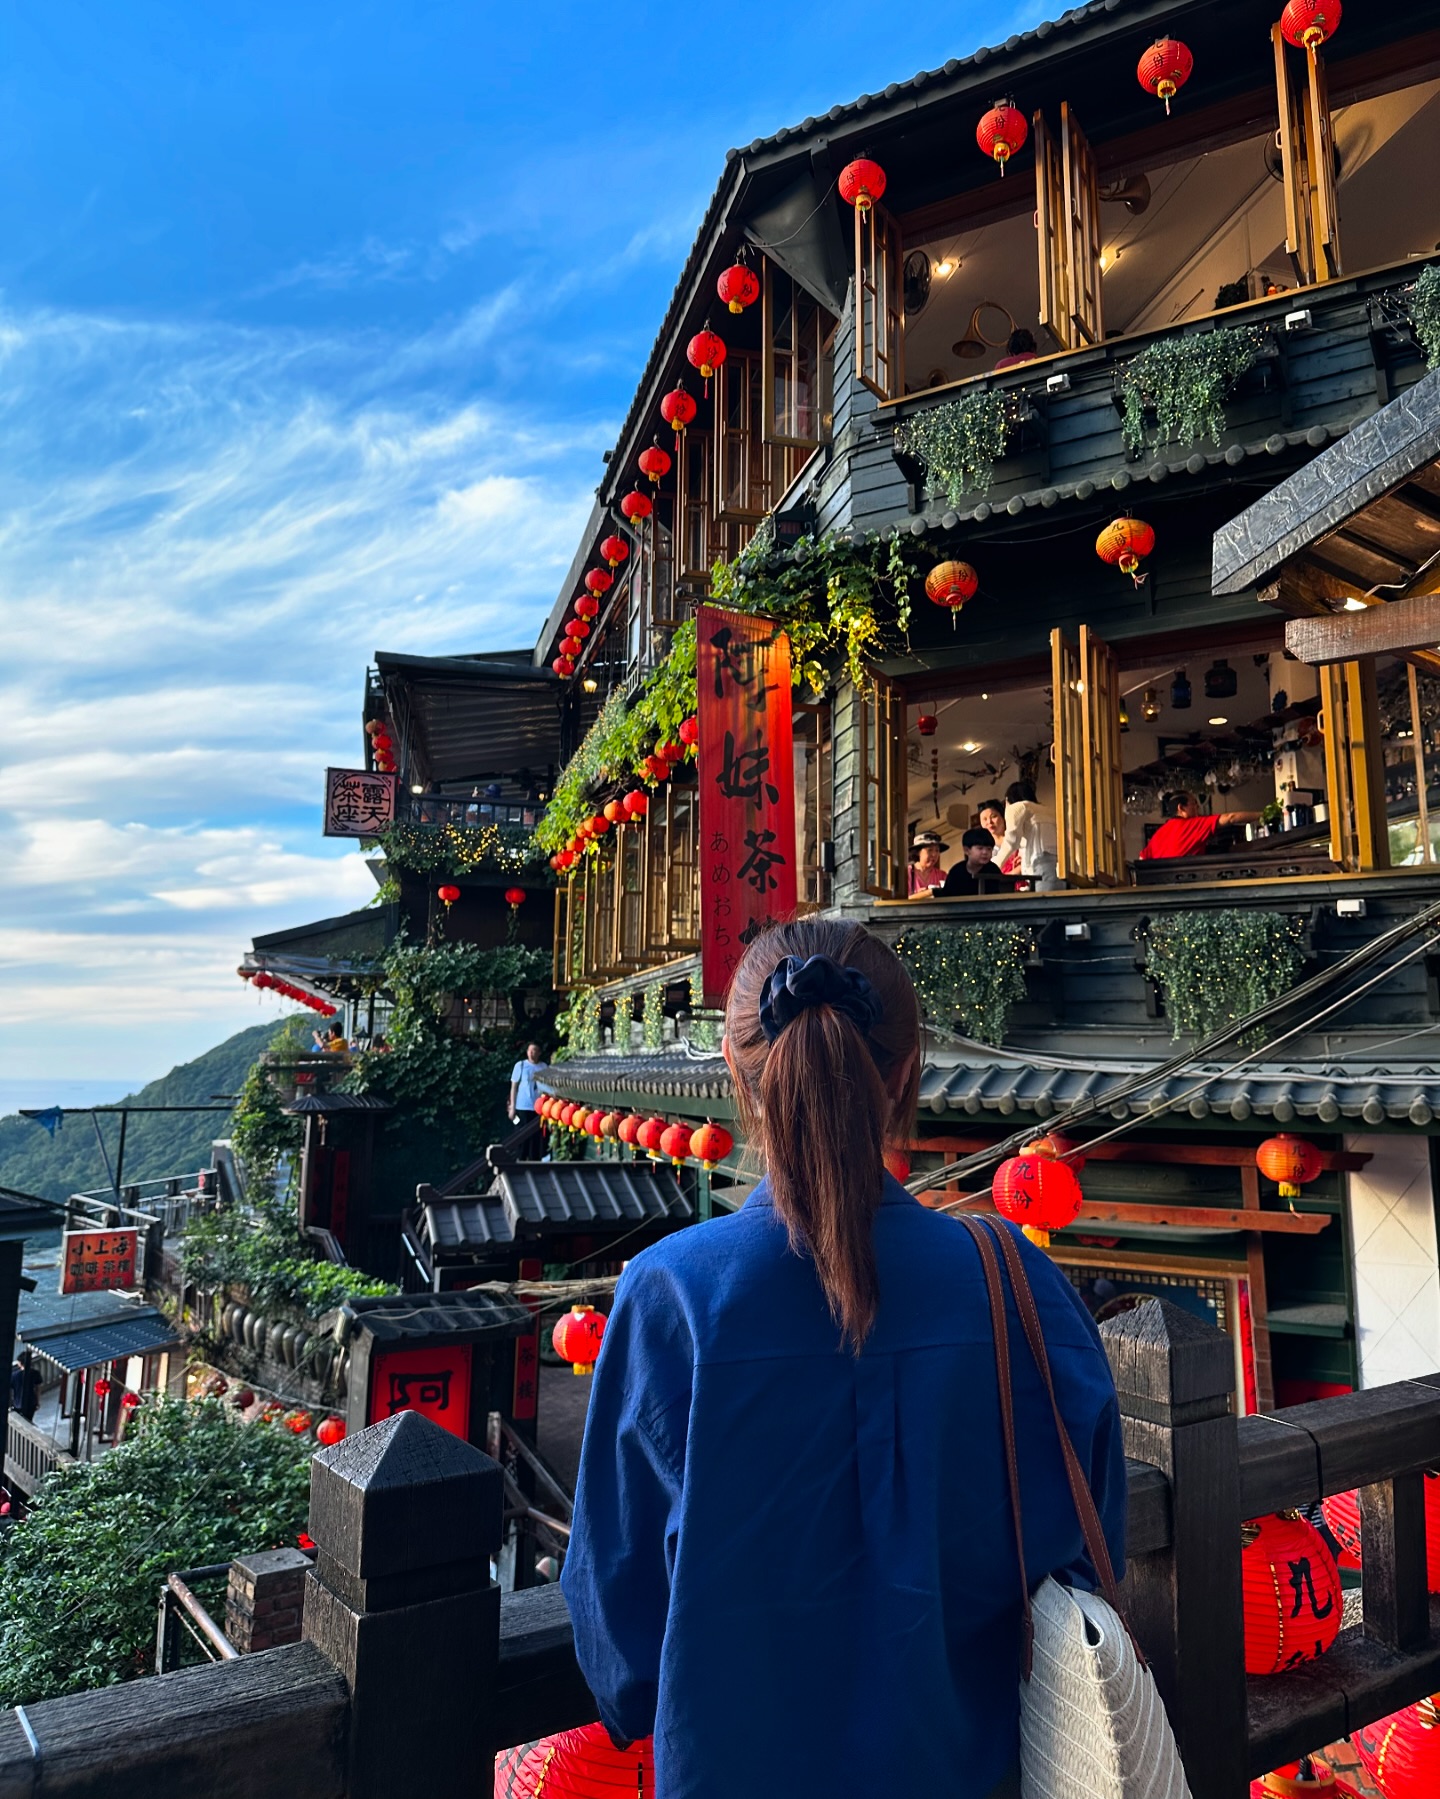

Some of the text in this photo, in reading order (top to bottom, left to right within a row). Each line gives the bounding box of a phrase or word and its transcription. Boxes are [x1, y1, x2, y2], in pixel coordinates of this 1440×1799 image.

[1014, 1162, 1034, 1209] 九份
[72, 1236, 129, 1255] 小上海
